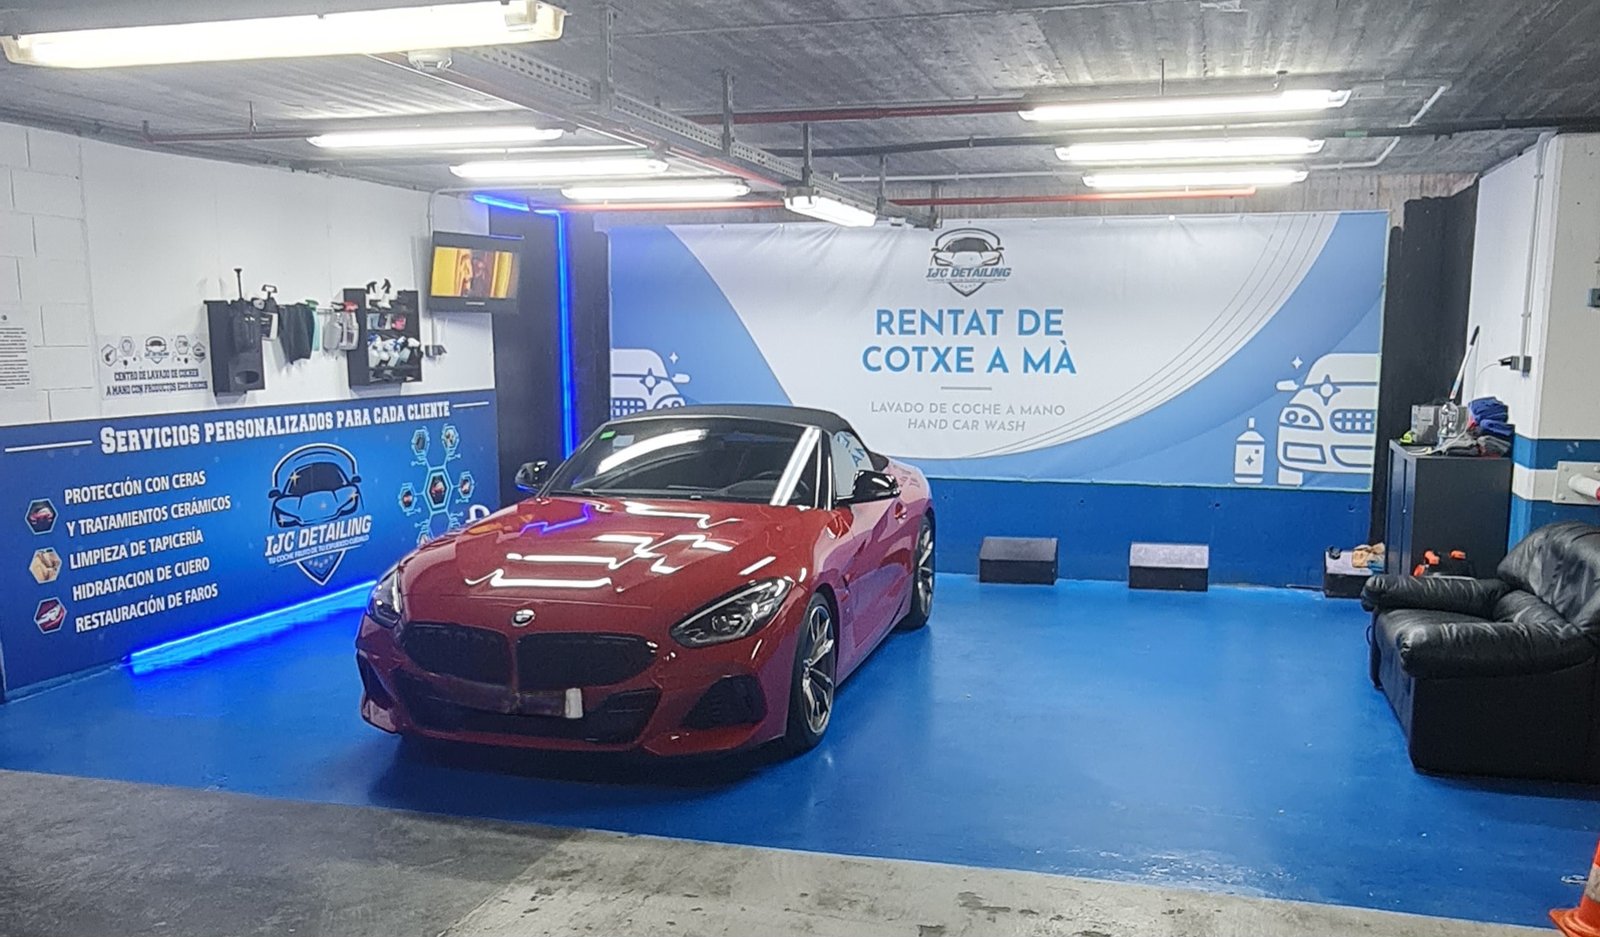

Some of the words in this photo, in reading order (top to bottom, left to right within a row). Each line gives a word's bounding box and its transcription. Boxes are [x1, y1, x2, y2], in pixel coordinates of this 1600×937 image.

[926, 268, 949, 278] IJC
[950, 267, 1012, 278] DETAILING
[876, 308, 1004, 336] RENTAT
[1018, 308, 1064, 336] DE
[862, 345, 975, 373] COTXE
[986, 346, 1009, 373] A
[1022, 339, 1077, 374] MÀ
[106, 385, 112, 396] A
[112, 385, 130, 395] MANO
[131, 384, 143, 394] CON
[114, 370, 138, 381] CENTRO
[139, 370, 146, 380] DE
[147, 369, 170, 380] LAVADO
[170, 369, 178, 379] DE
[204, 411, 333, 443] PERSONALIZADOS
[336, 408, 371, 428] PARA
[373, 404, 406, 424] CADA
[407, 400, 450, 420] CLIENTE
[871, 401, 924, 414] LAVADO
[929, 402, 947, 414] DE
[952, 403, 1000, 415] COCHE
[1006, 404, 1015, 415] A
[1020, 404, 1065, 416] MANO
[907, 418, 948, 430] HAND
[952, 419, 979, 431] CAR
[985, 420, 1026, 432] WASH
[64, 475, 142, 505] PROTECCIÓN
[145, 475, 170, 493] CON
[172, 470, 206, 489] CERAS
[66, 521, 76, 537] Y
[79, 505, 168, 535] TRATAMIENTOS
[171, 495, 231, 519] CERÁMICOS
[69, 544, 128, 569] LIMPIEZA
[130, 540, 146, 557] DE
[148, 526, 204, 552] TAPICERÍA
[265, 531, 296, 556] IJC
[299, 515, 372, 548] DETAILING
[73, 569, 154, 601] HIDRATACION
[156, 565, 172, 582] DE
[174, 556, 210, 577] CUERO
[75, 594, 165, 633] RESTAURACIÓN
[167, 592, 183, 609] DE
[185, 583, 218, 604] FAROS
